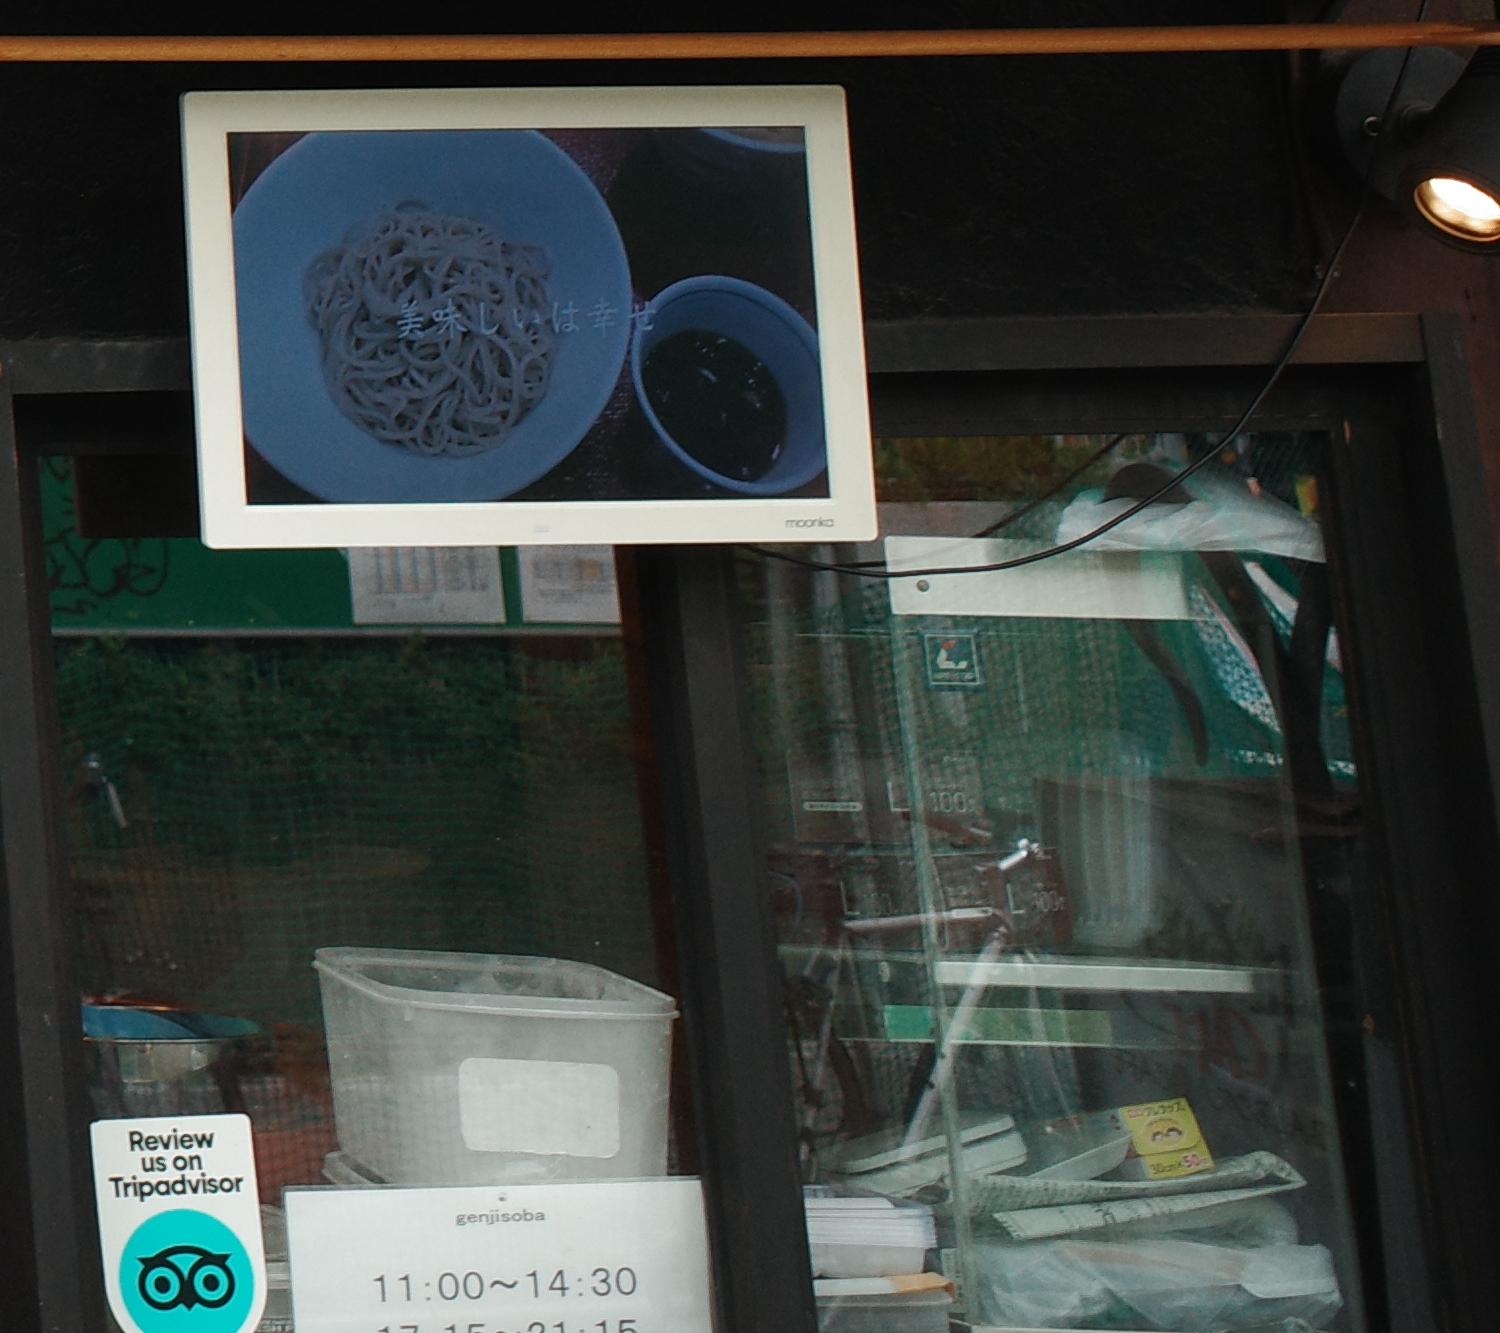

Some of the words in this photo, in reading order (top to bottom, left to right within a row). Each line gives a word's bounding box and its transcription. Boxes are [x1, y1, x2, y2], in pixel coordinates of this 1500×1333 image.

[397, 298, 657, 338] 美味しいは幸せ
[128, 1128, 215, 1152] Review
[141, 1156, 167, 1172] us
[172, 1154, 203, 1171] on
[108, 1172, 244, 1202] Tripadvisor
[456, 1209, 546, 1226] genjisoba
